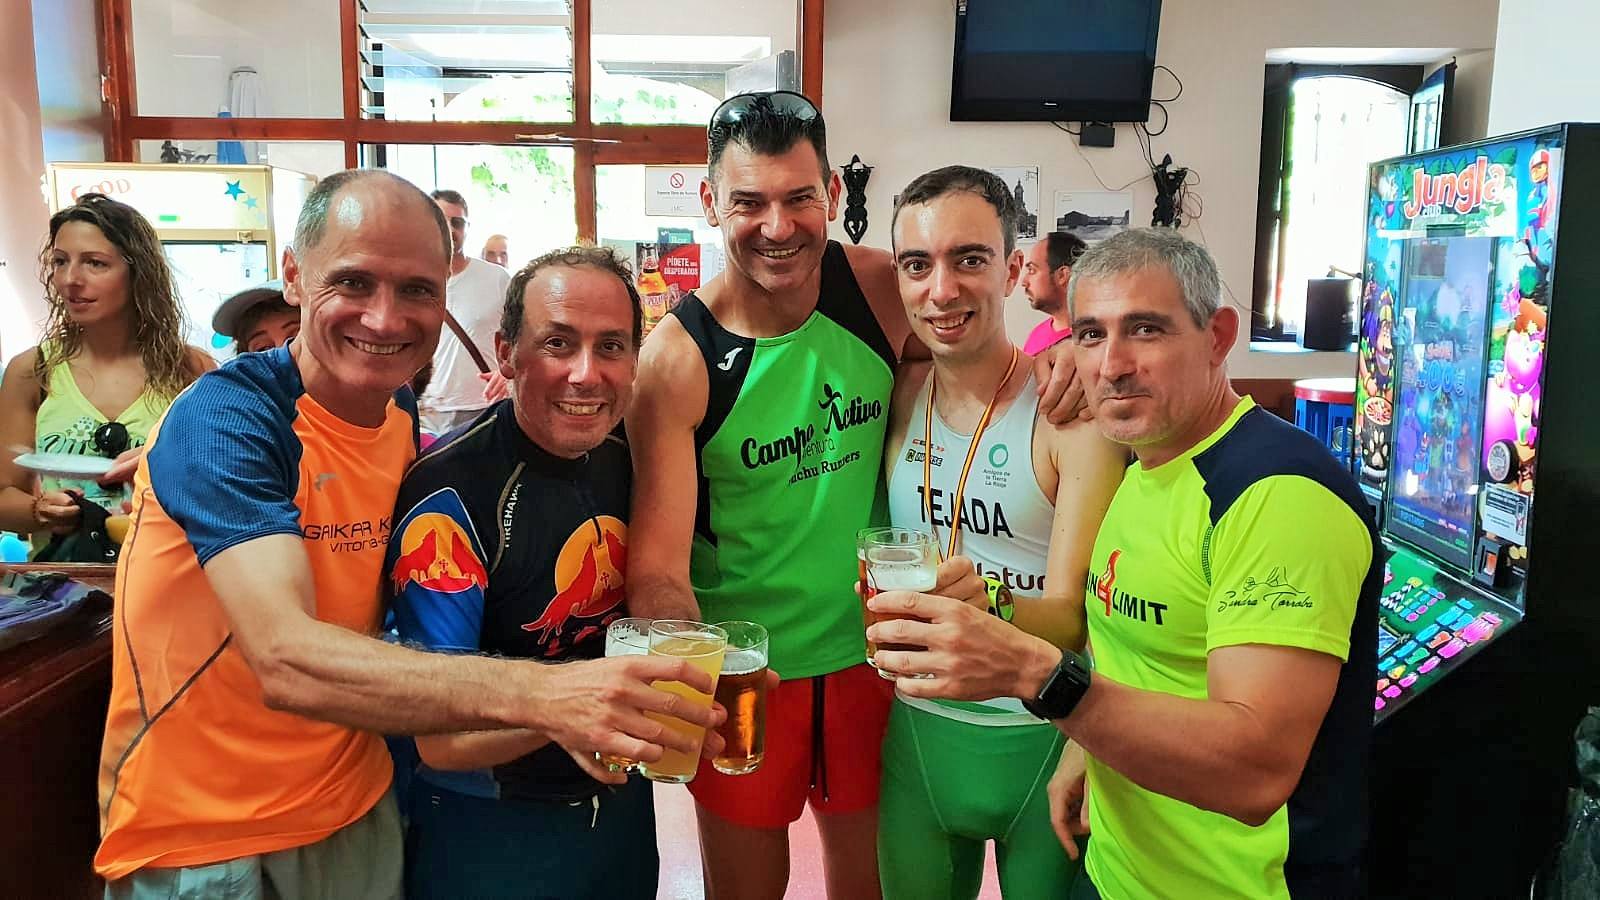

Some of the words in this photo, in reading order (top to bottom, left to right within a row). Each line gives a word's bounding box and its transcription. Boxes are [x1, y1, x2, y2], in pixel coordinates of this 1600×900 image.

[1404, 156, 1506, 219] Jungla
[667, 256, 689, 266] PÍDETE
[740, 424, 815, 471] Campo
[822, 396, 882, 435] Activo
[820, 450, 860, 474] Runers
[983, 468, 1003, 477] Amigos
[917, 484, 1015, 539] TEJADA
[303, 520, 372, 541] GAIKAR
